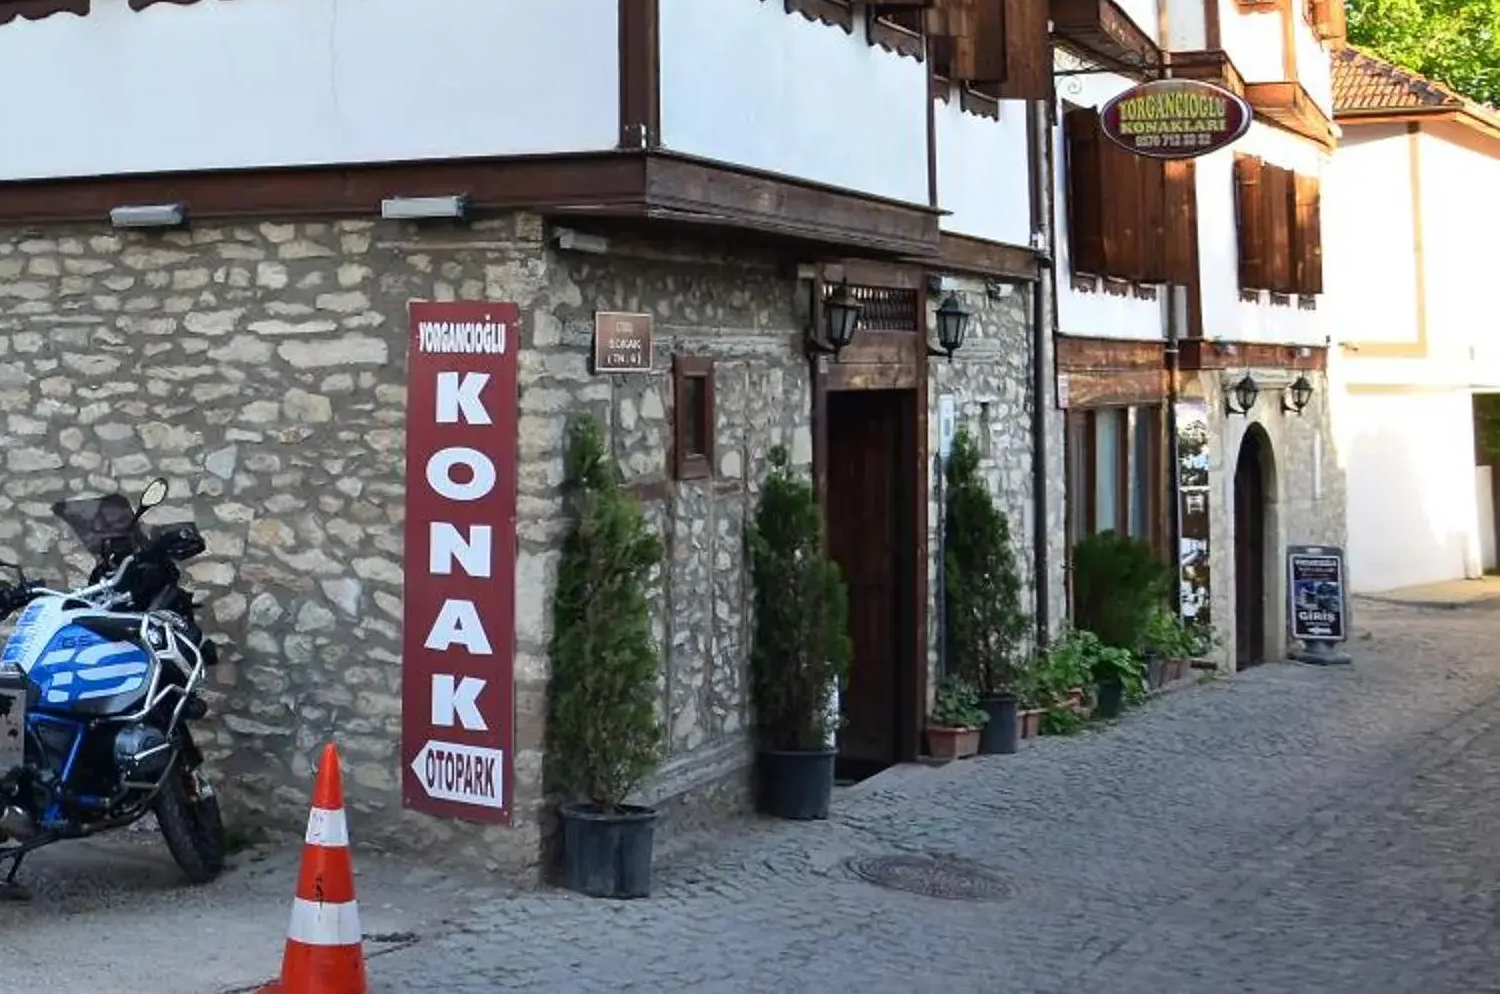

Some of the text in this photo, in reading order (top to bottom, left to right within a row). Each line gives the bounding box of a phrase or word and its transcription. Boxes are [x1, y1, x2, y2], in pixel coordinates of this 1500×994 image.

[418, 314, 507, 355] YORGANCIOĞLU
[424, 371, 497, 732] KONAK
[424, 748, 496, 799] OTOPARK
